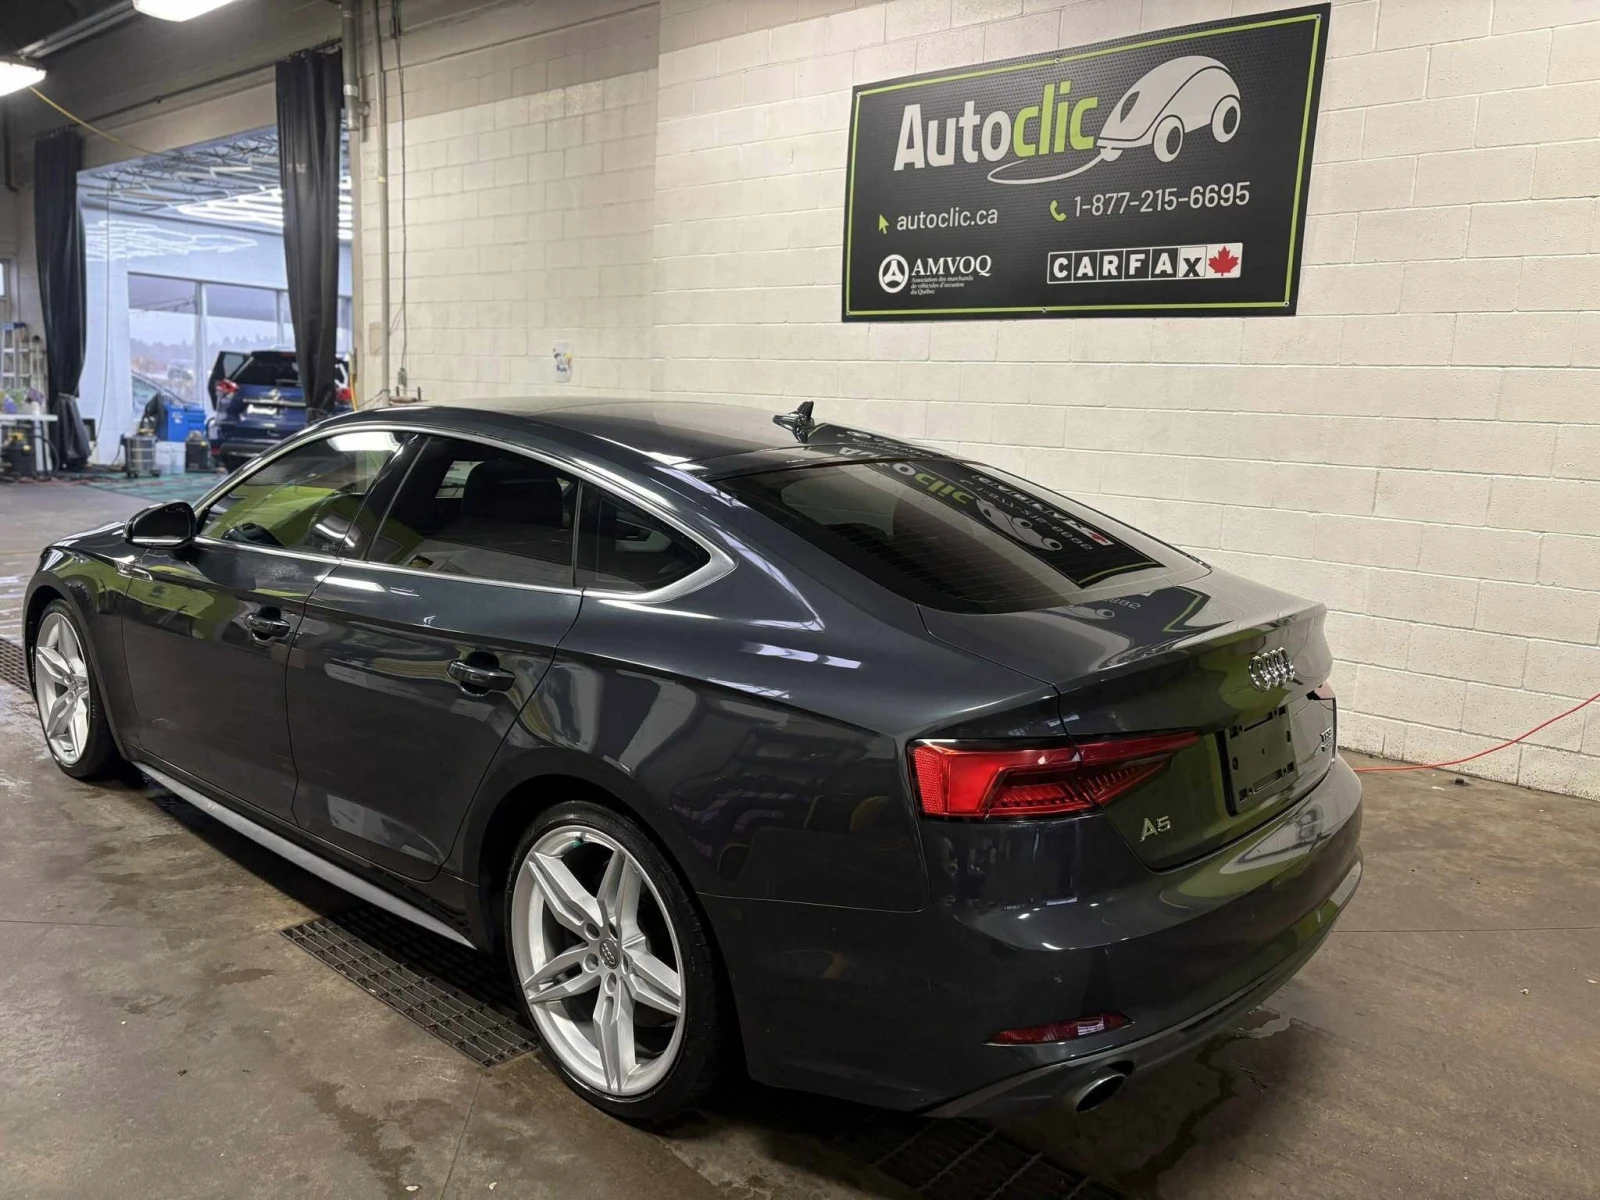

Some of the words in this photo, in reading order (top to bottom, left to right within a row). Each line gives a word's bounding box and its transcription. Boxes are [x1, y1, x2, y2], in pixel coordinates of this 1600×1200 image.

[893, 80, 1099, 172] Autoclic
[1073, 181, 1251, 218] 1-877-215-6695
[896, 208, 998, 231] autoclic.ca
[911, 254, 992, 277] AMVOQ
[1052, 251, 1207, 279] CARFAX
[1139, 815, 1171, 842] A5
